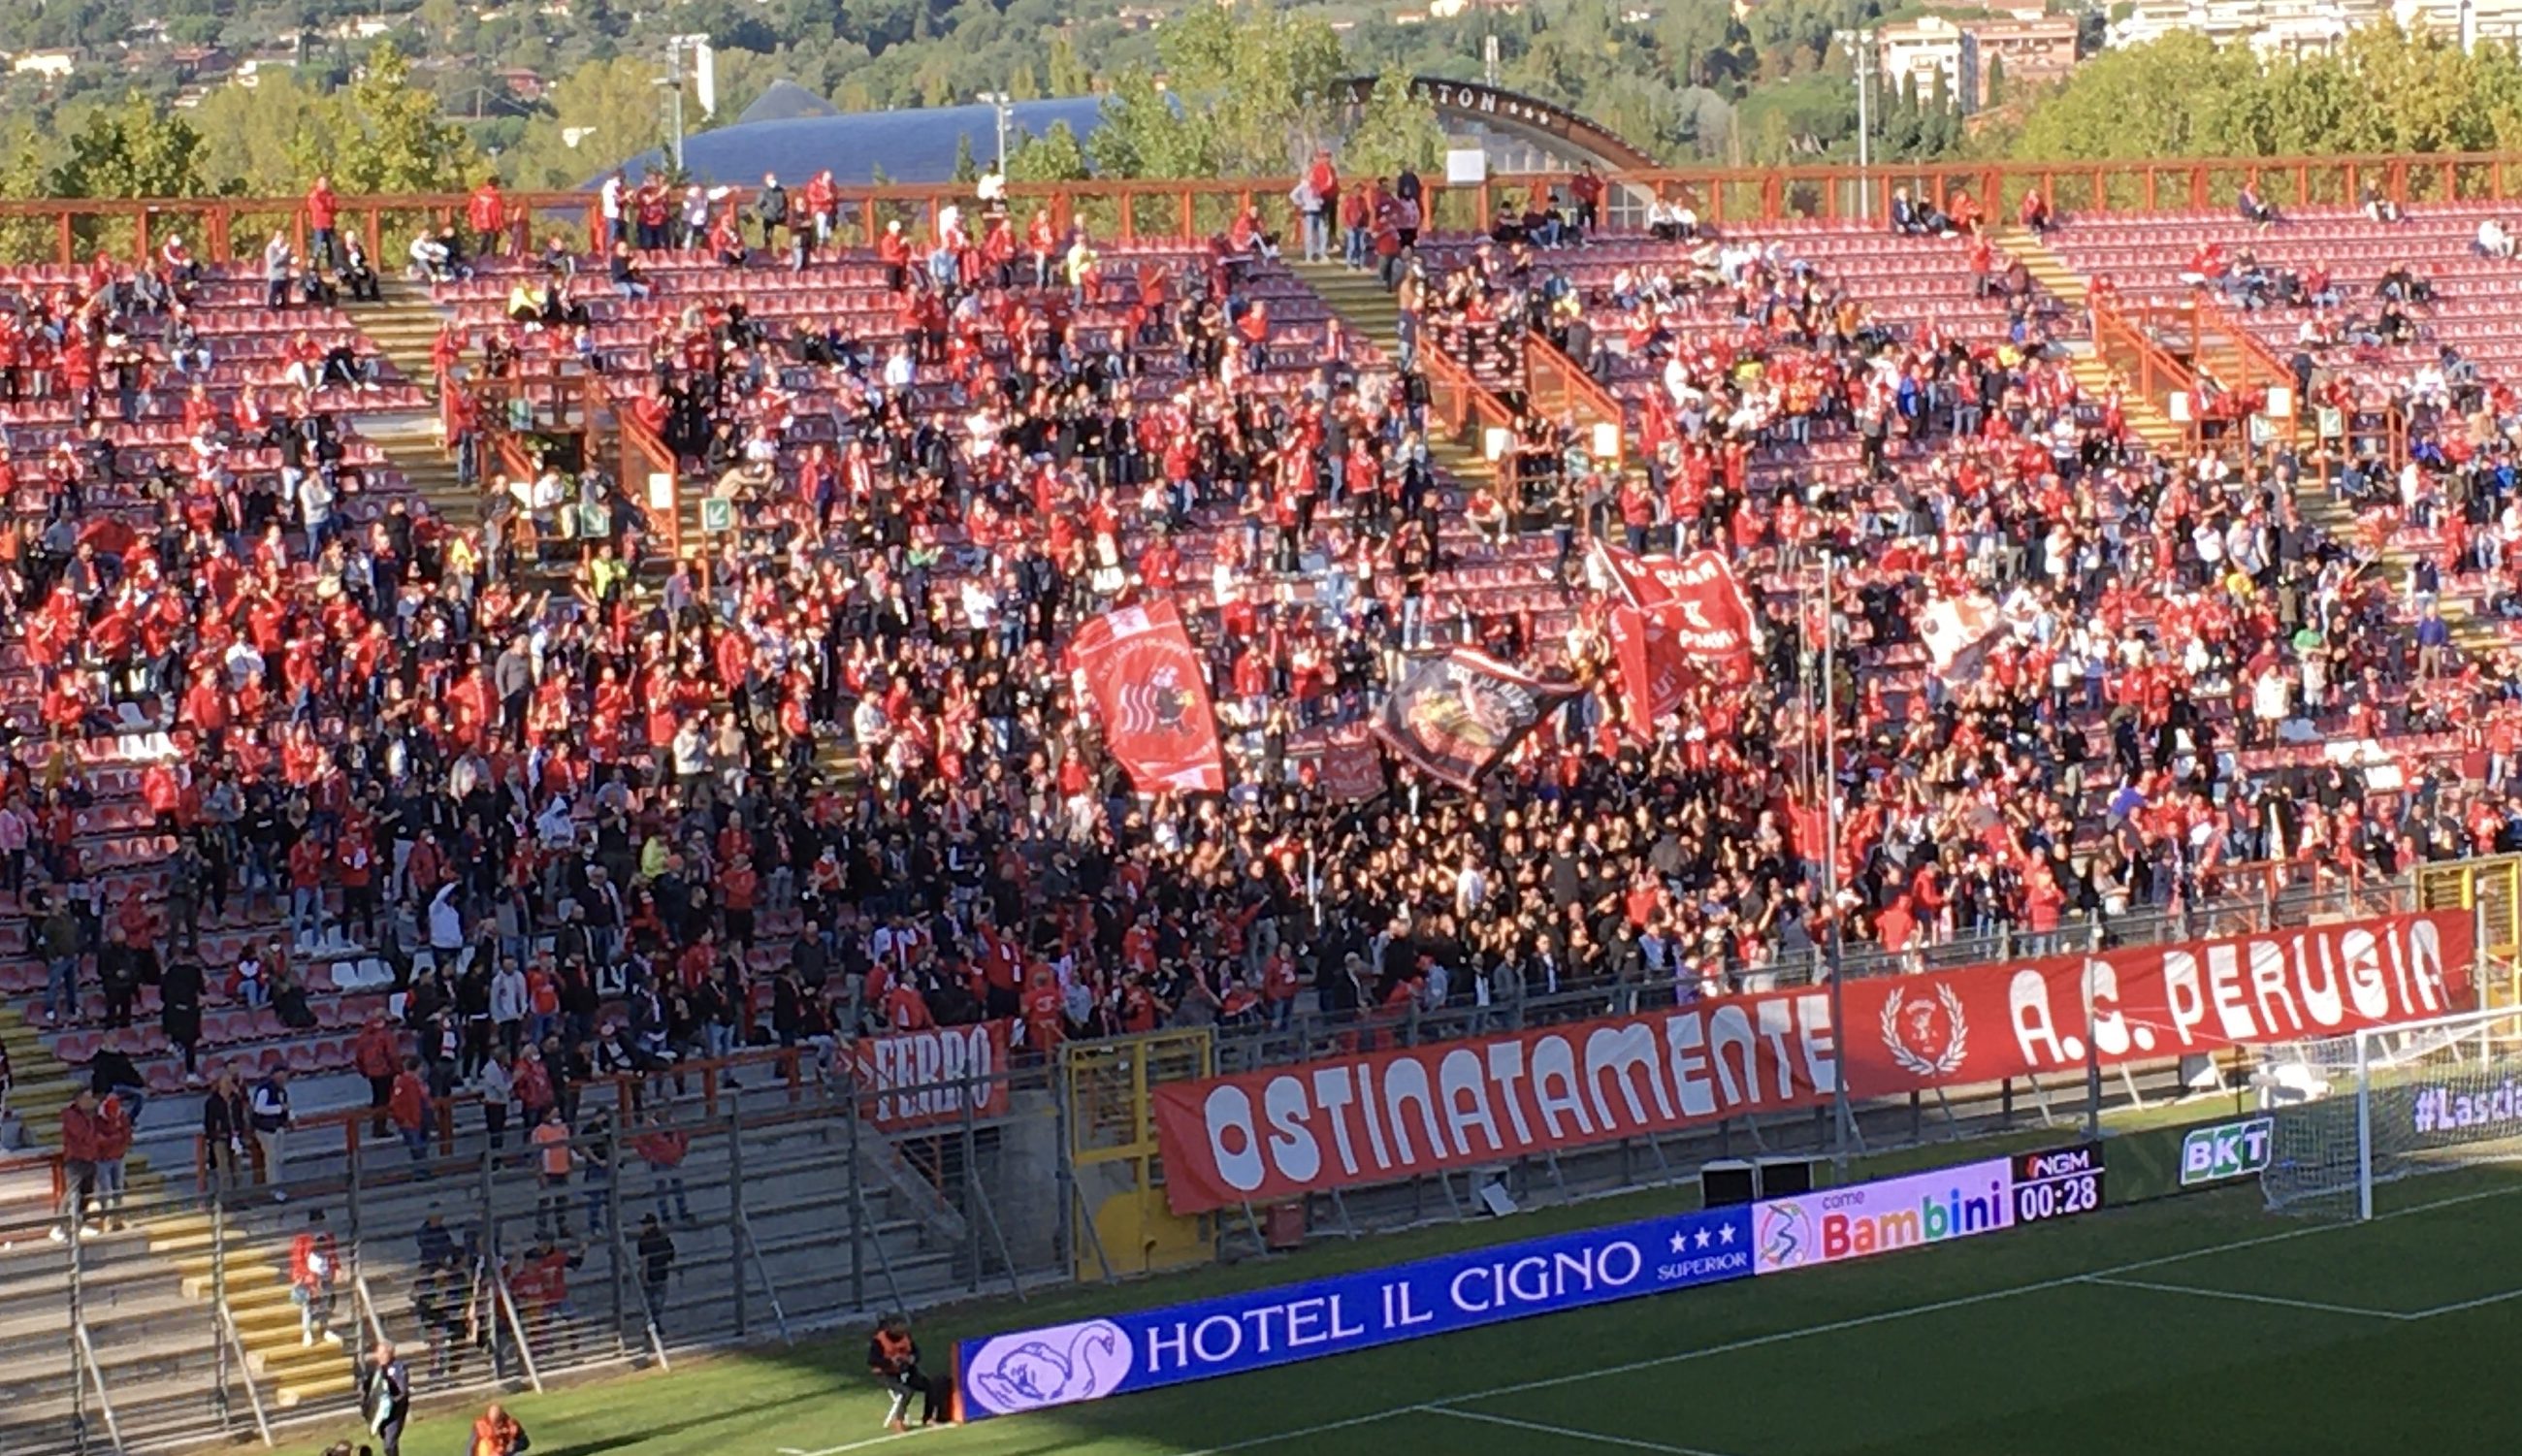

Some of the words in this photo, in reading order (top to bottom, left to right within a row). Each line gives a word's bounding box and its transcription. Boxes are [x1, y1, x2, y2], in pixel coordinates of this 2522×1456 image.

[2009, 960, 2155, 1066] A.C.
[2163, 919, 2451, 1045] PERUGIA
[875, 1024, 990, 1122] FERRO
[1204, 993, 1849, 1190] OSTINATAMENTE
[2032, 1149, 2089, 1179] NGM
[2187, 1129, 2268, 1172] BKT
[1822, 1190, 1864, 1210] come
[1823, 1181, 2001, 1258] Bambini
[2021, 1176, 2097, 1221] 00:28
[1657, 1251, 1748, 1281] SUPERIOR
[1147, 1293, 1365, 1372] HOTEL
[1382, 1281, 1434, 1329] IL
[1450, 1241, 1641, 1311] CIGNO
